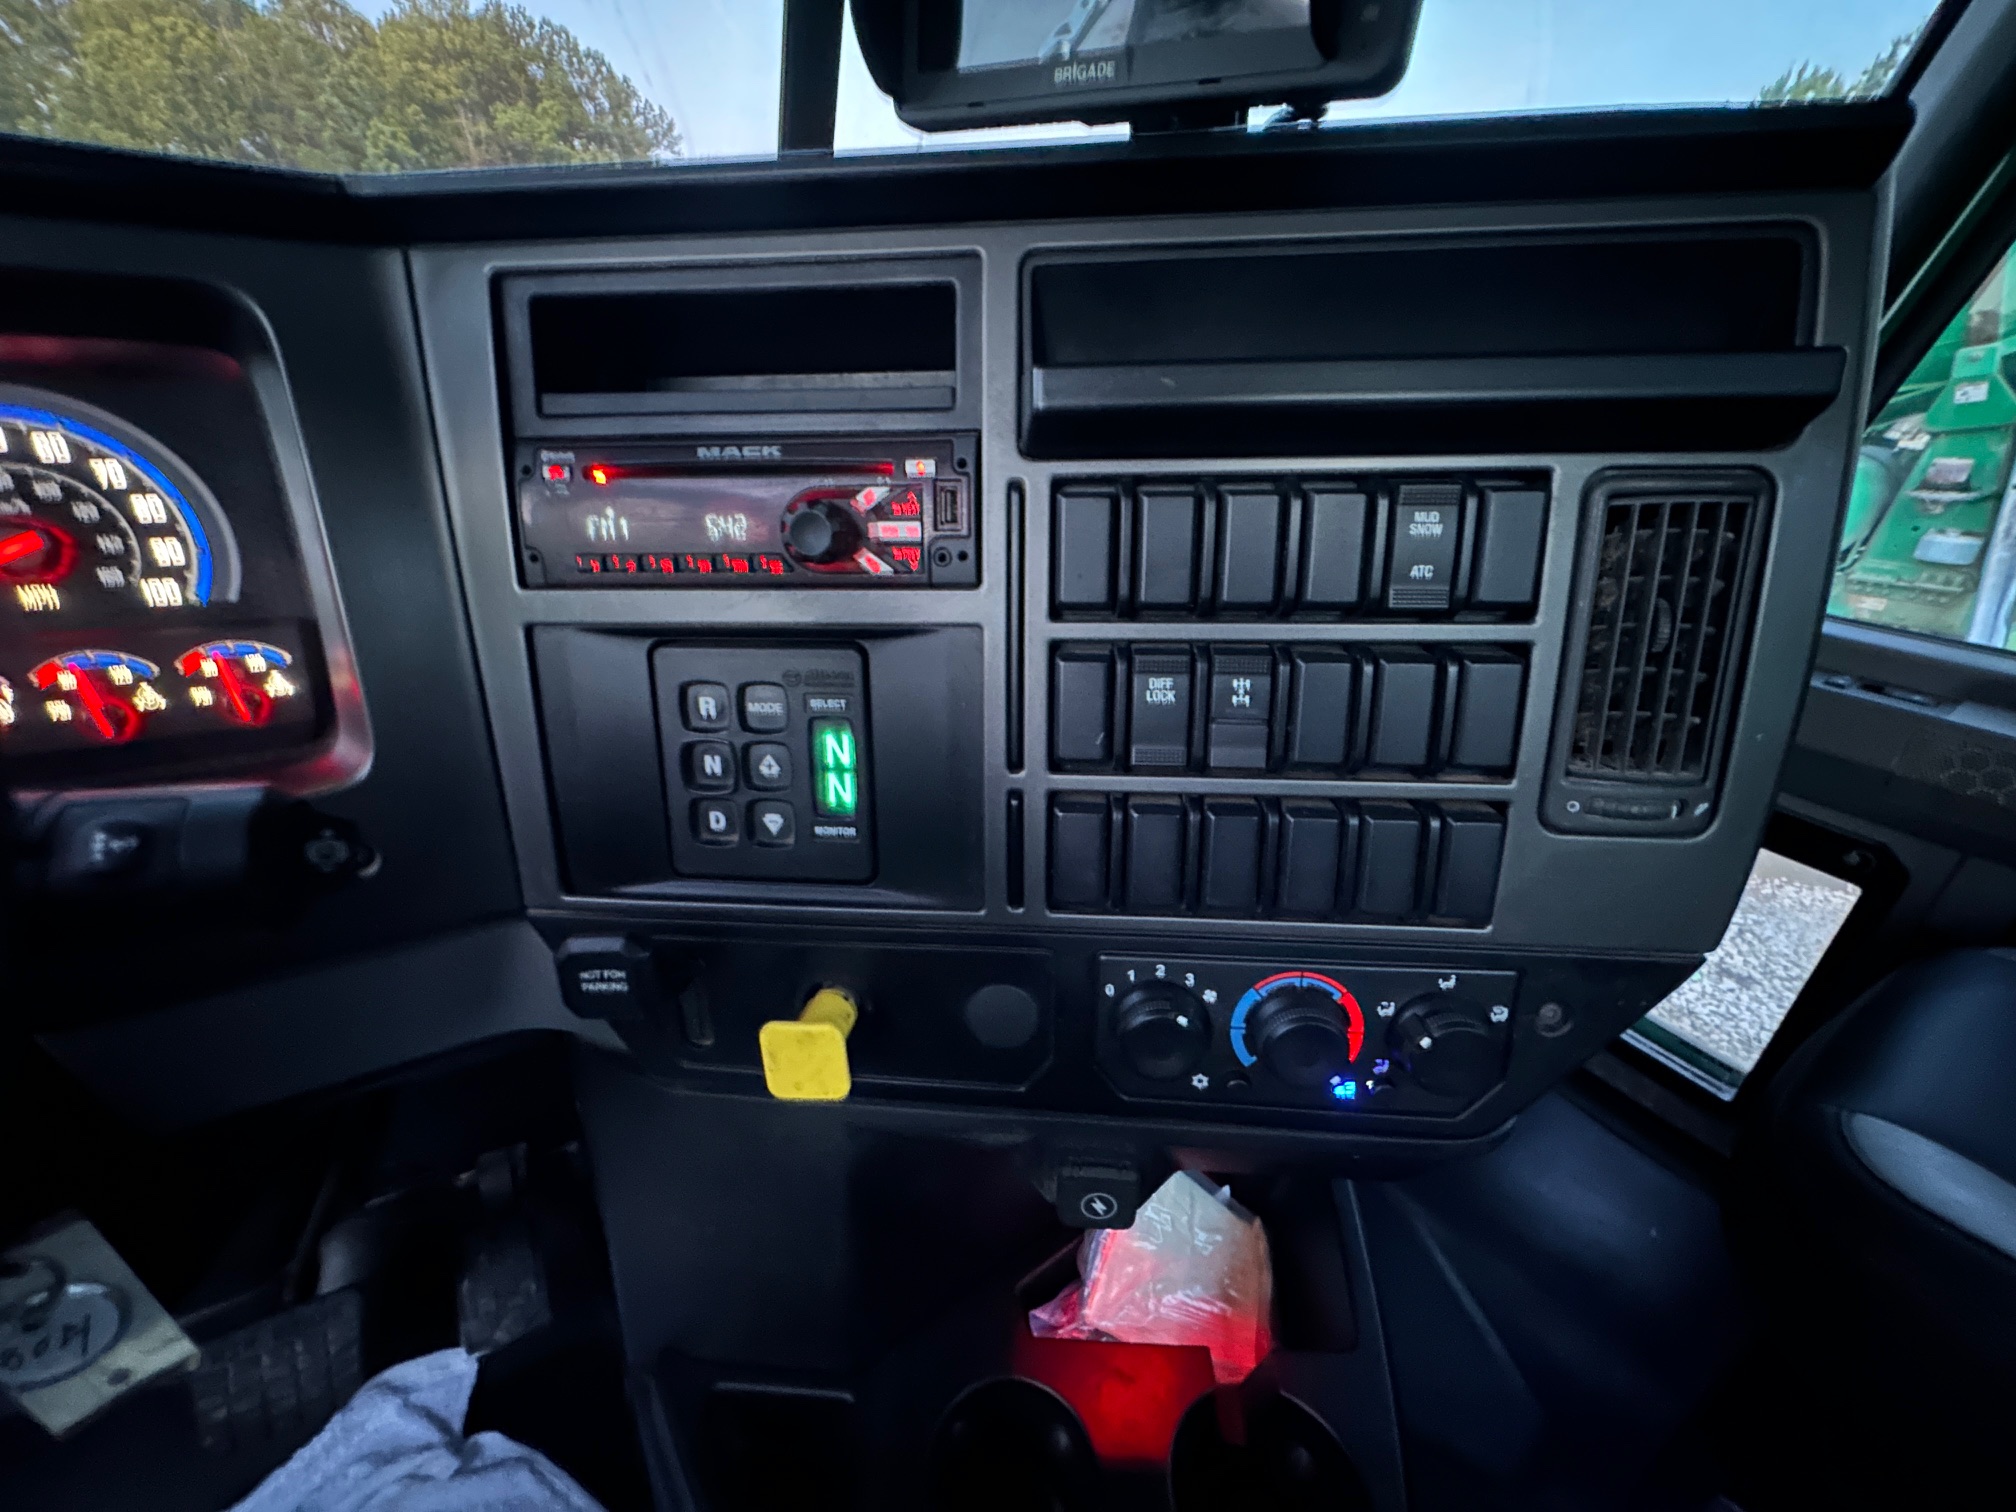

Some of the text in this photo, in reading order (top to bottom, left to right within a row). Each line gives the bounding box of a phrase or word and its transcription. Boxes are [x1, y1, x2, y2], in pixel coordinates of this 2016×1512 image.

[1054, 60, 1116, 84] BRIGADE
[697, 446, 782, 460] MACK
[89, 458, 127, 490] 70
[130, 493, 168, 524] 80
[1414, 511, 1440, 523] MUD
[1409, 523, 1443, 538] SNOW
[149, 537, 186, 567] 90
[1409, 564, 1435, 580] ATC
[16, 583, 61, 612] MPH
[139, 577, 183, 608] 100
[1148, 677, 1174, 690] DIFF
[810, 698, 847, 711] SELECT
[1146, 689, 1176, 705] LOCK
[698, 695, 717, 720] R
[747, 702, 784, 716] MODE
[822, 731, 852, 769] N
[703, 754, 722, 777] N
[825, 771, 853, 808] N
[708, 810, 727, 832] D
[814, 826, 857, 838] MONITOR
[1127, 969, 1135, 983] 1
[1155, 964, 1166, 979] 2
[580, 981, 629, 993] PARKING
[1185, 972, 1195, 988] 3
[1104, 983, 1115, 998] 0
